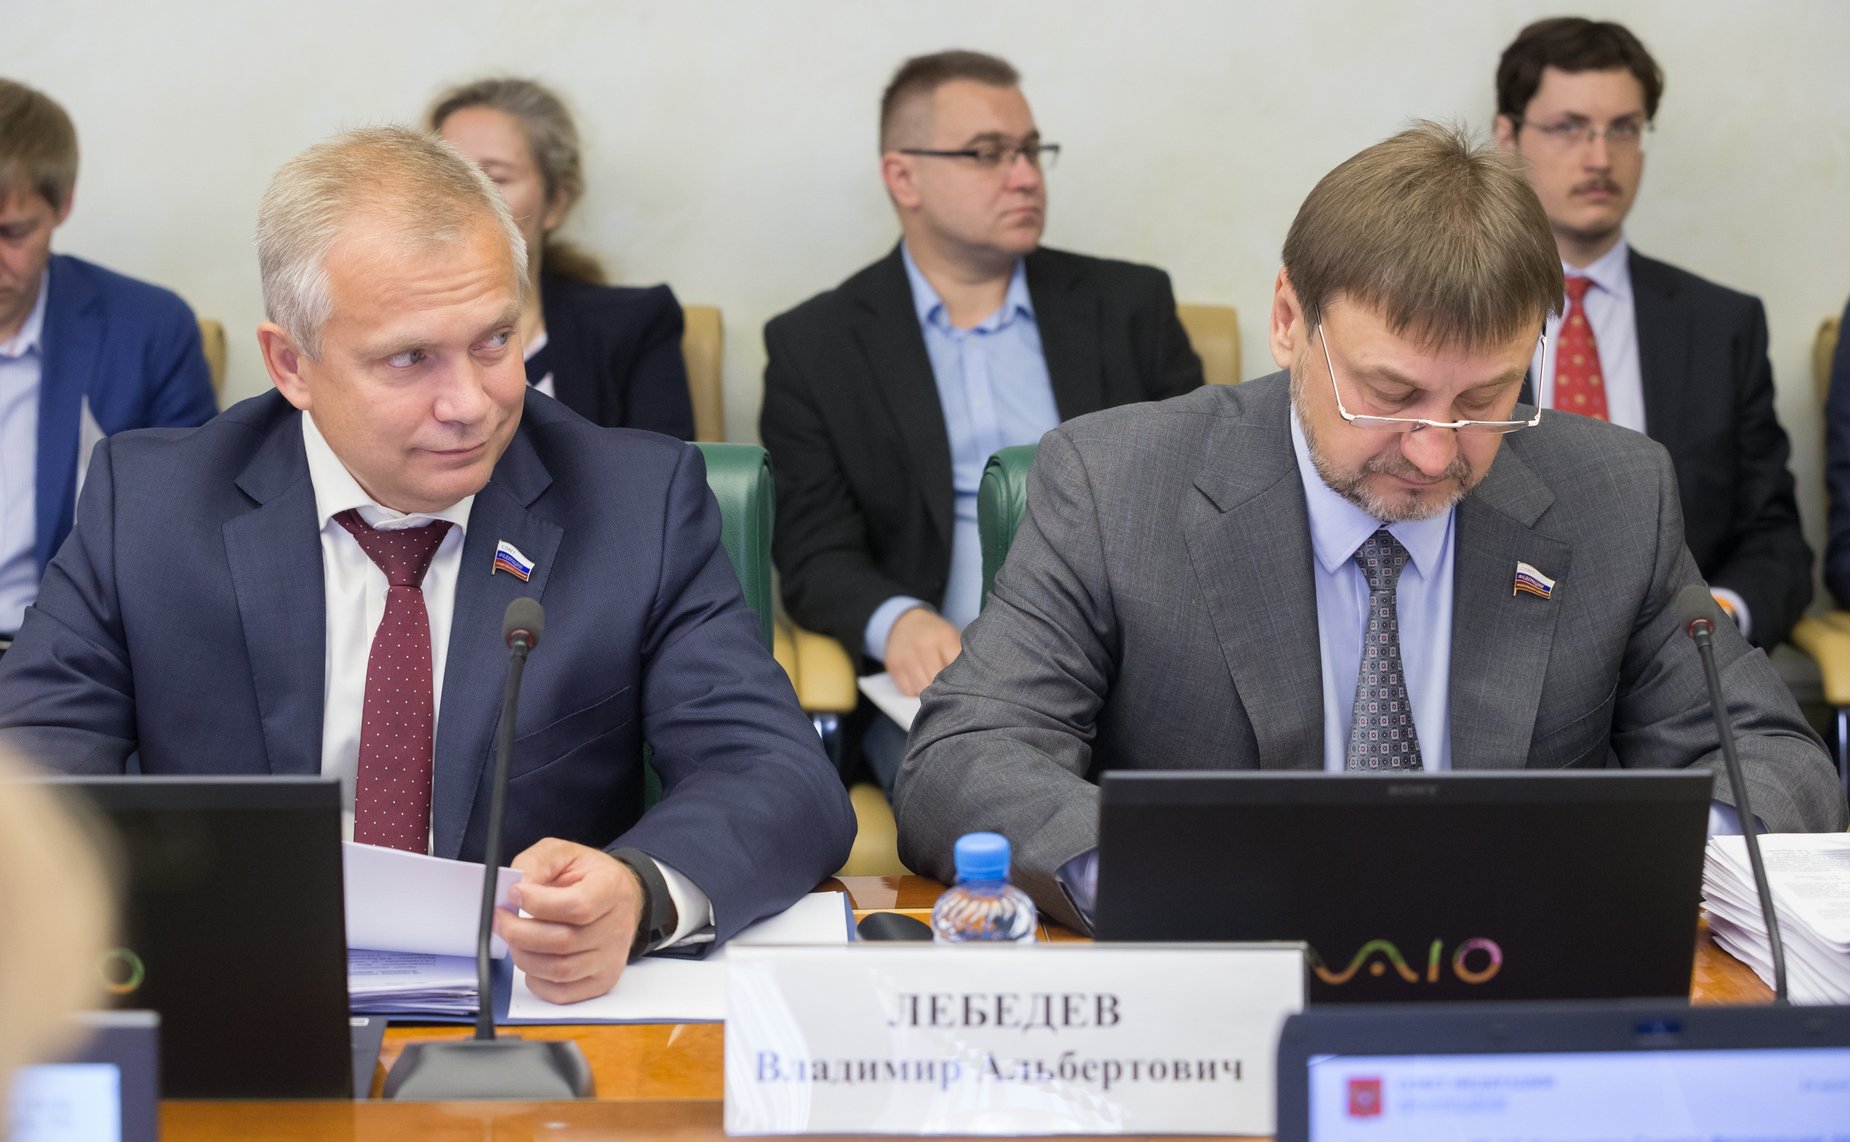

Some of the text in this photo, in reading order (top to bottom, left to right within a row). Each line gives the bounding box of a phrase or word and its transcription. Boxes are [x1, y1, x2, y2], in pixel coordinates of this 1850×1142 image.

[886, 993, 1122, 1034] ЛЕБЕДЕВ
[756, 1050, 1243, 1091] Владимир Альбертович
